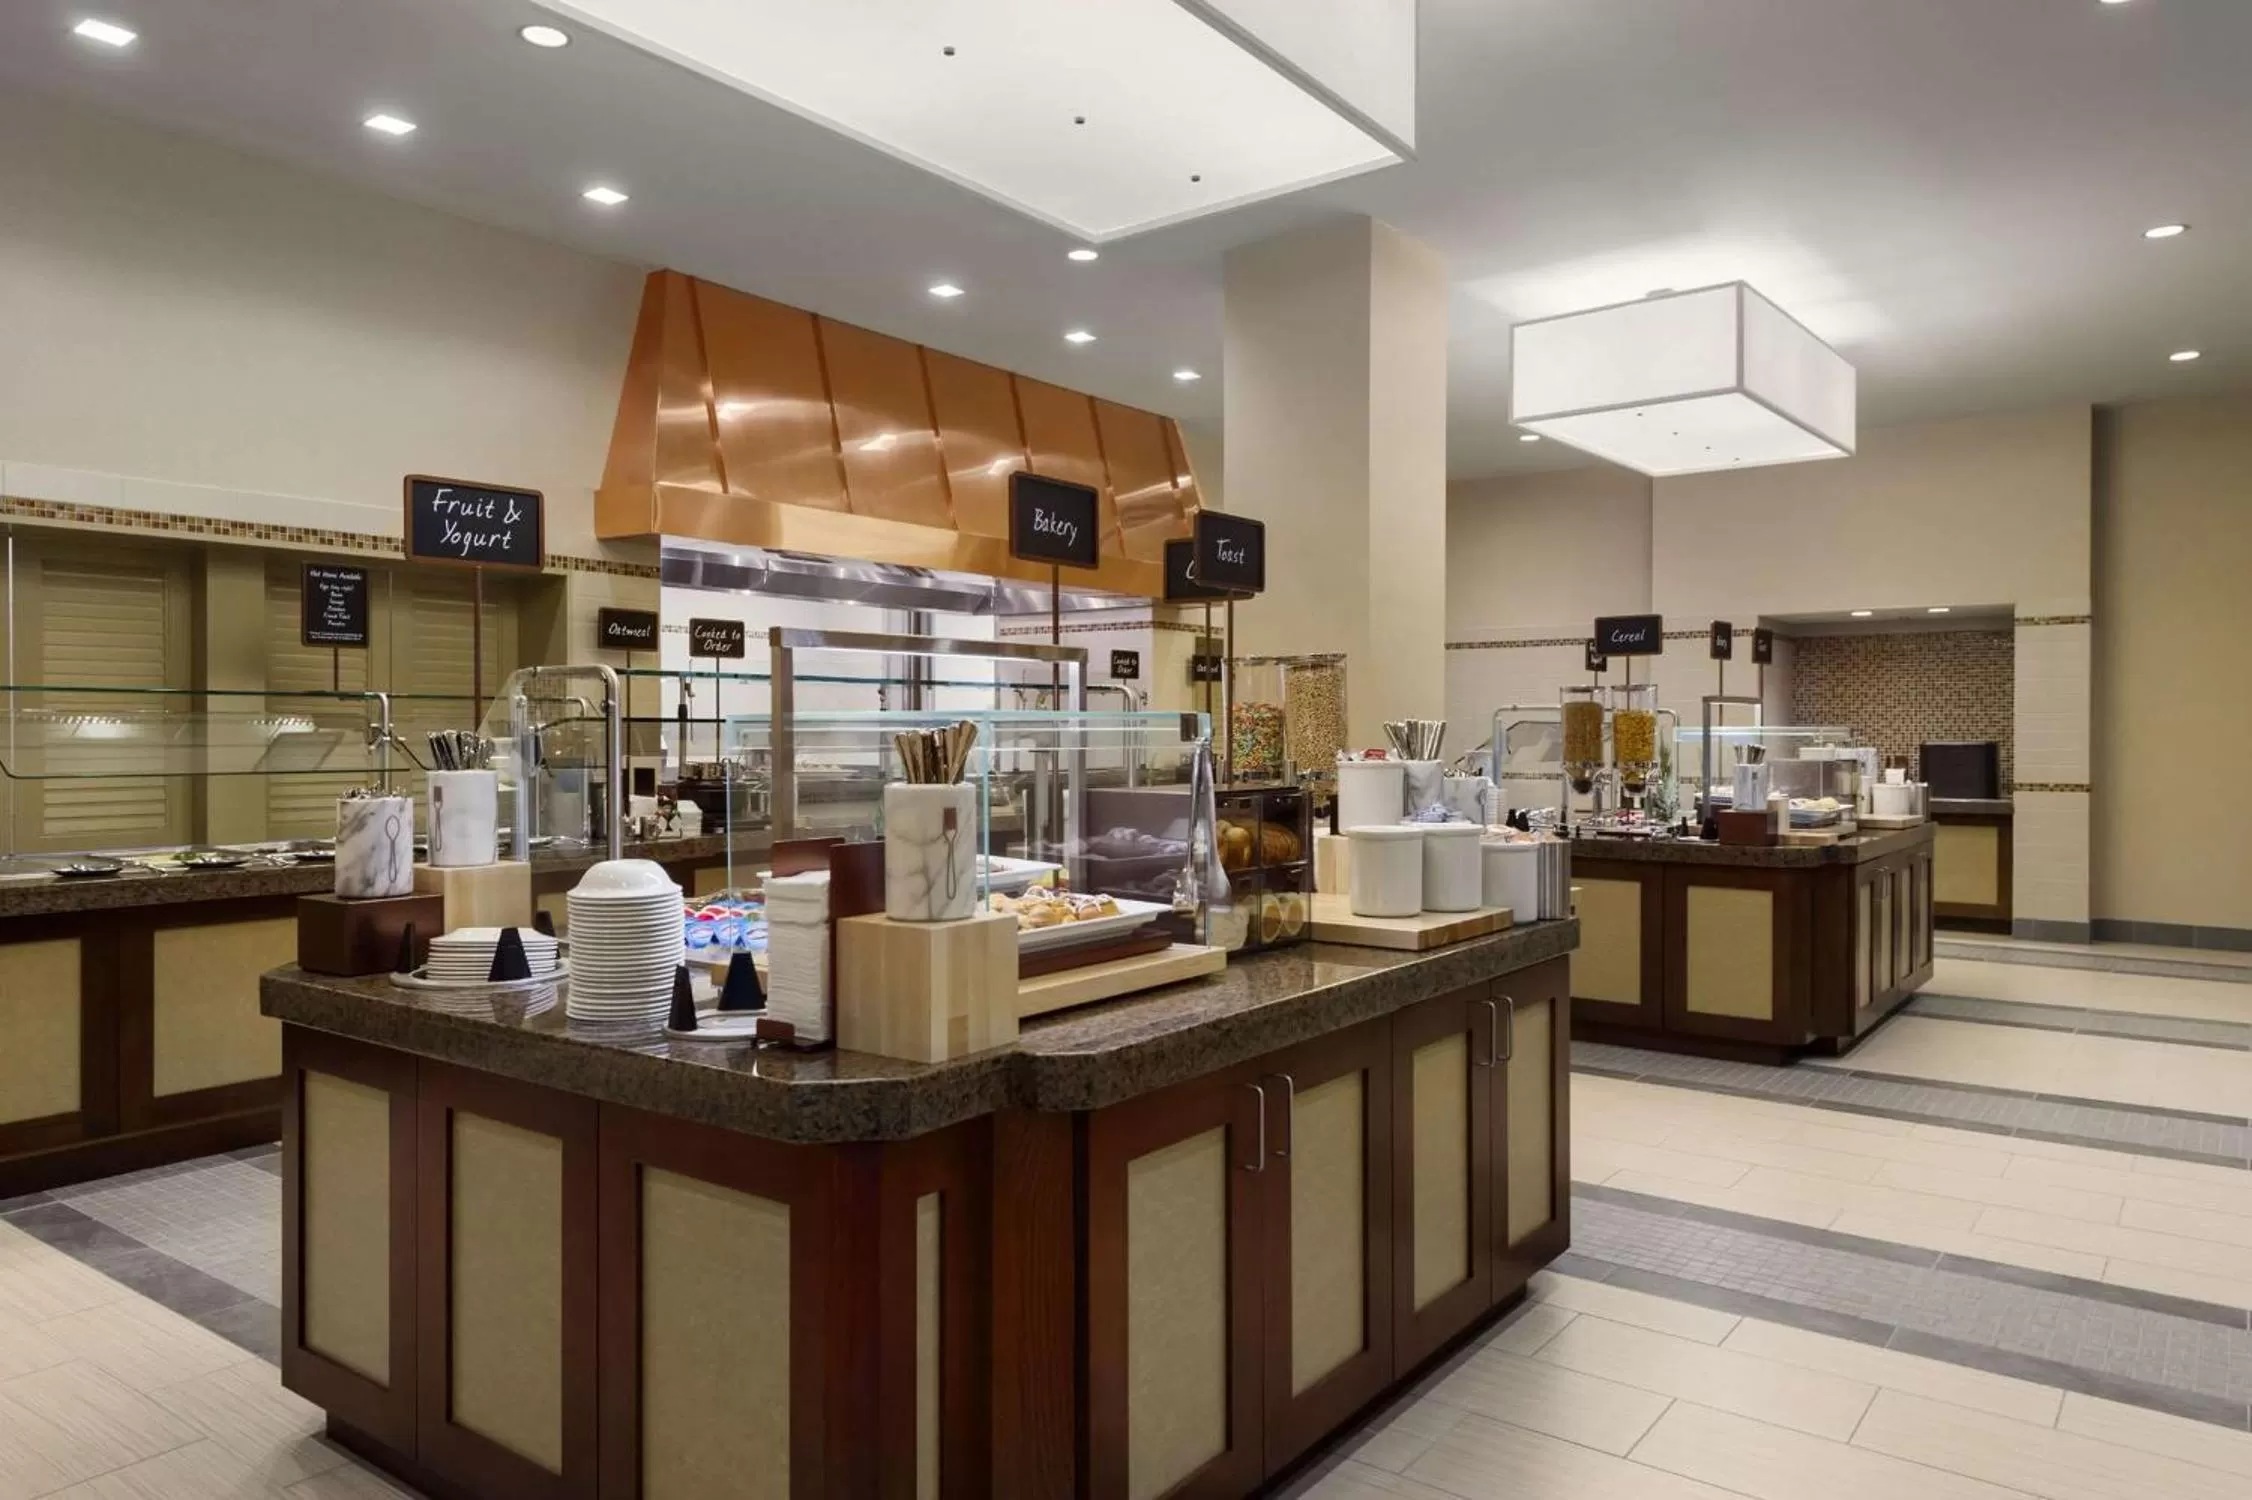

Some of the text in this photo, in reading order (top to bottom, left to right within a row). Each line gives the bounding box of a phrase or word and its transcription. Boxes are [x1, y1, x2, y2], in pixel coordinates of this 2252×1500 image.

[432, 488, 523, 524] Fruit &
[440, 519, 513, 556] Yogurt
[1033, 508, 1078, 547] Bakery
[1216, 538, 1245, 564] Toast
[608, 622, 651, 638] Oatmeal
[694, 625, 742, 640] Cooked to
[1611, 629, 1646, 643] Cereal
[703, 639, 732, 652] Order
